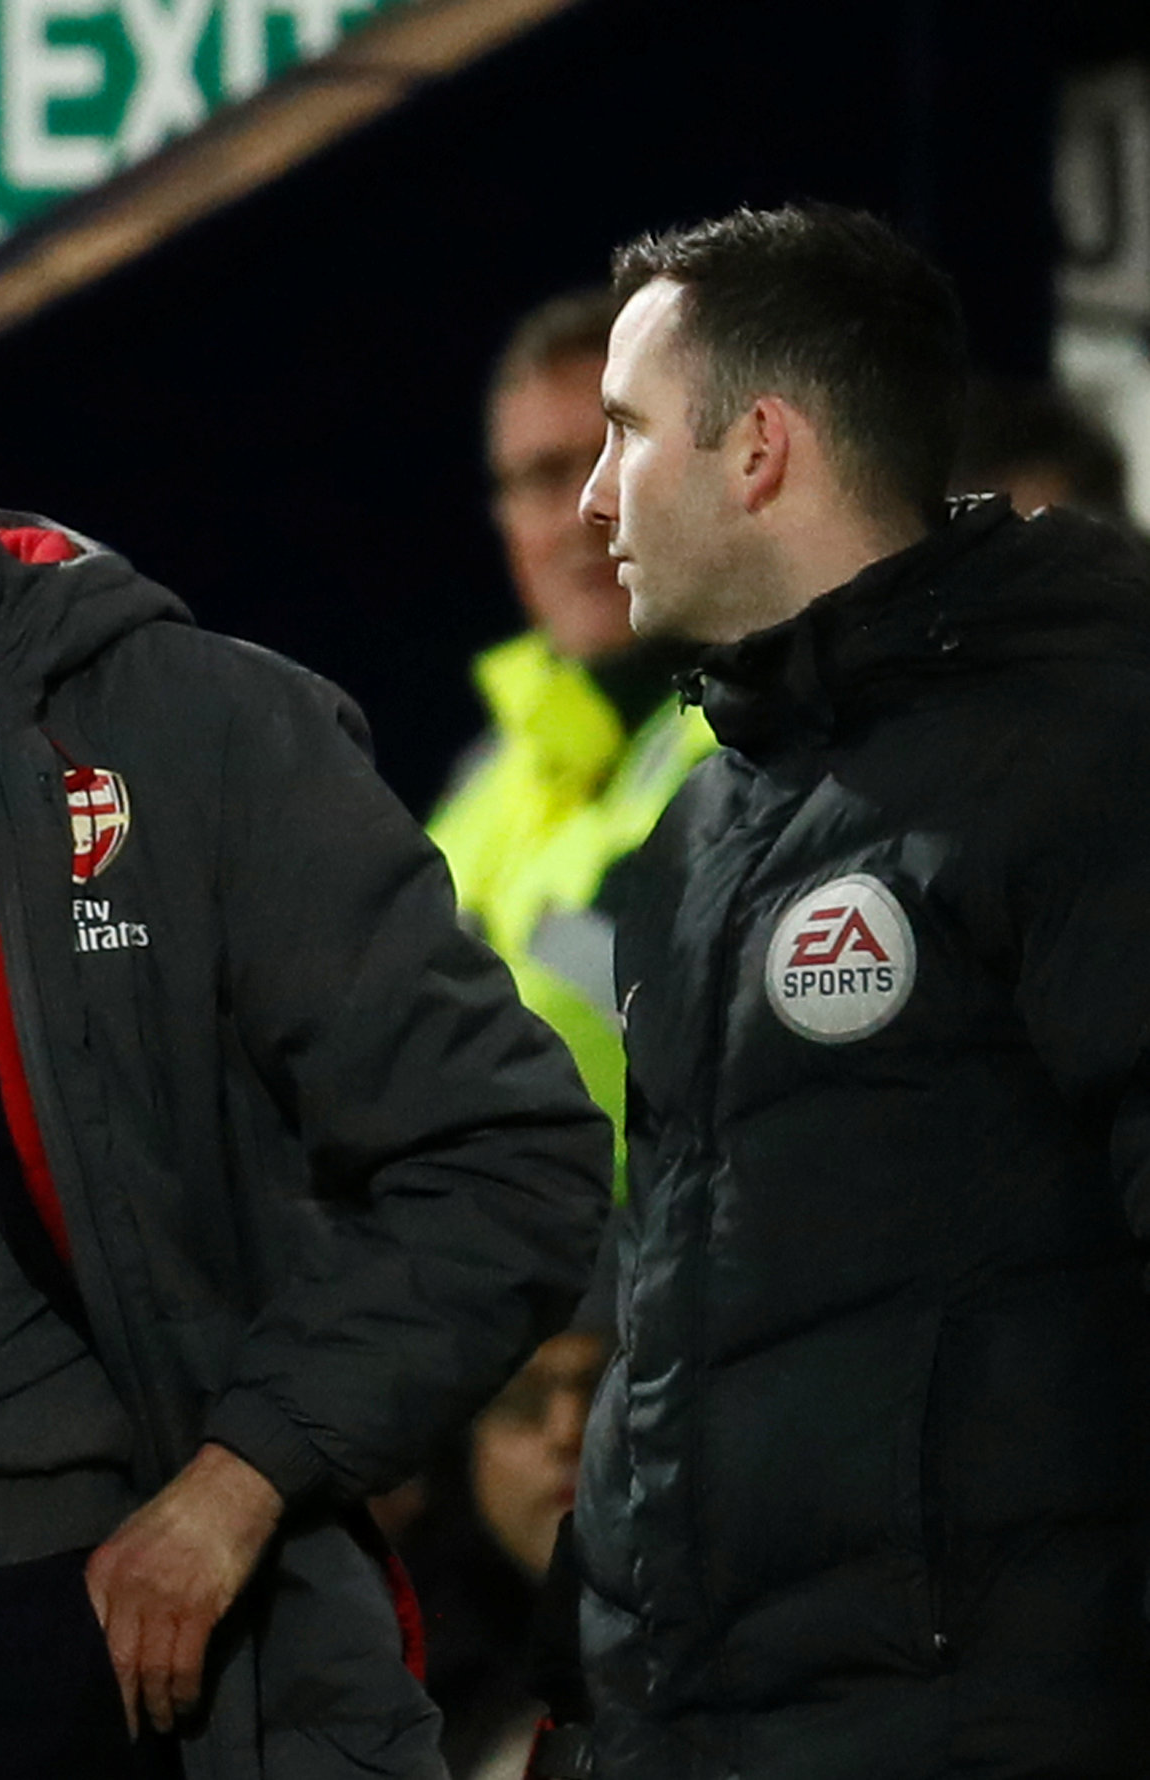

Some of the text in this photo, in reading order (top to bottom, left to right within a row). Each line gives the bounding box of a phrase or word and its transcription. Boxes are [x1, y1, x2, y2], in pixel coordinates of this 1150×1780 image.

[73, 900, 110, 921] Fly
[788, 906, 890, 968] EA
[783, 967, 894, 998] SPORTS
